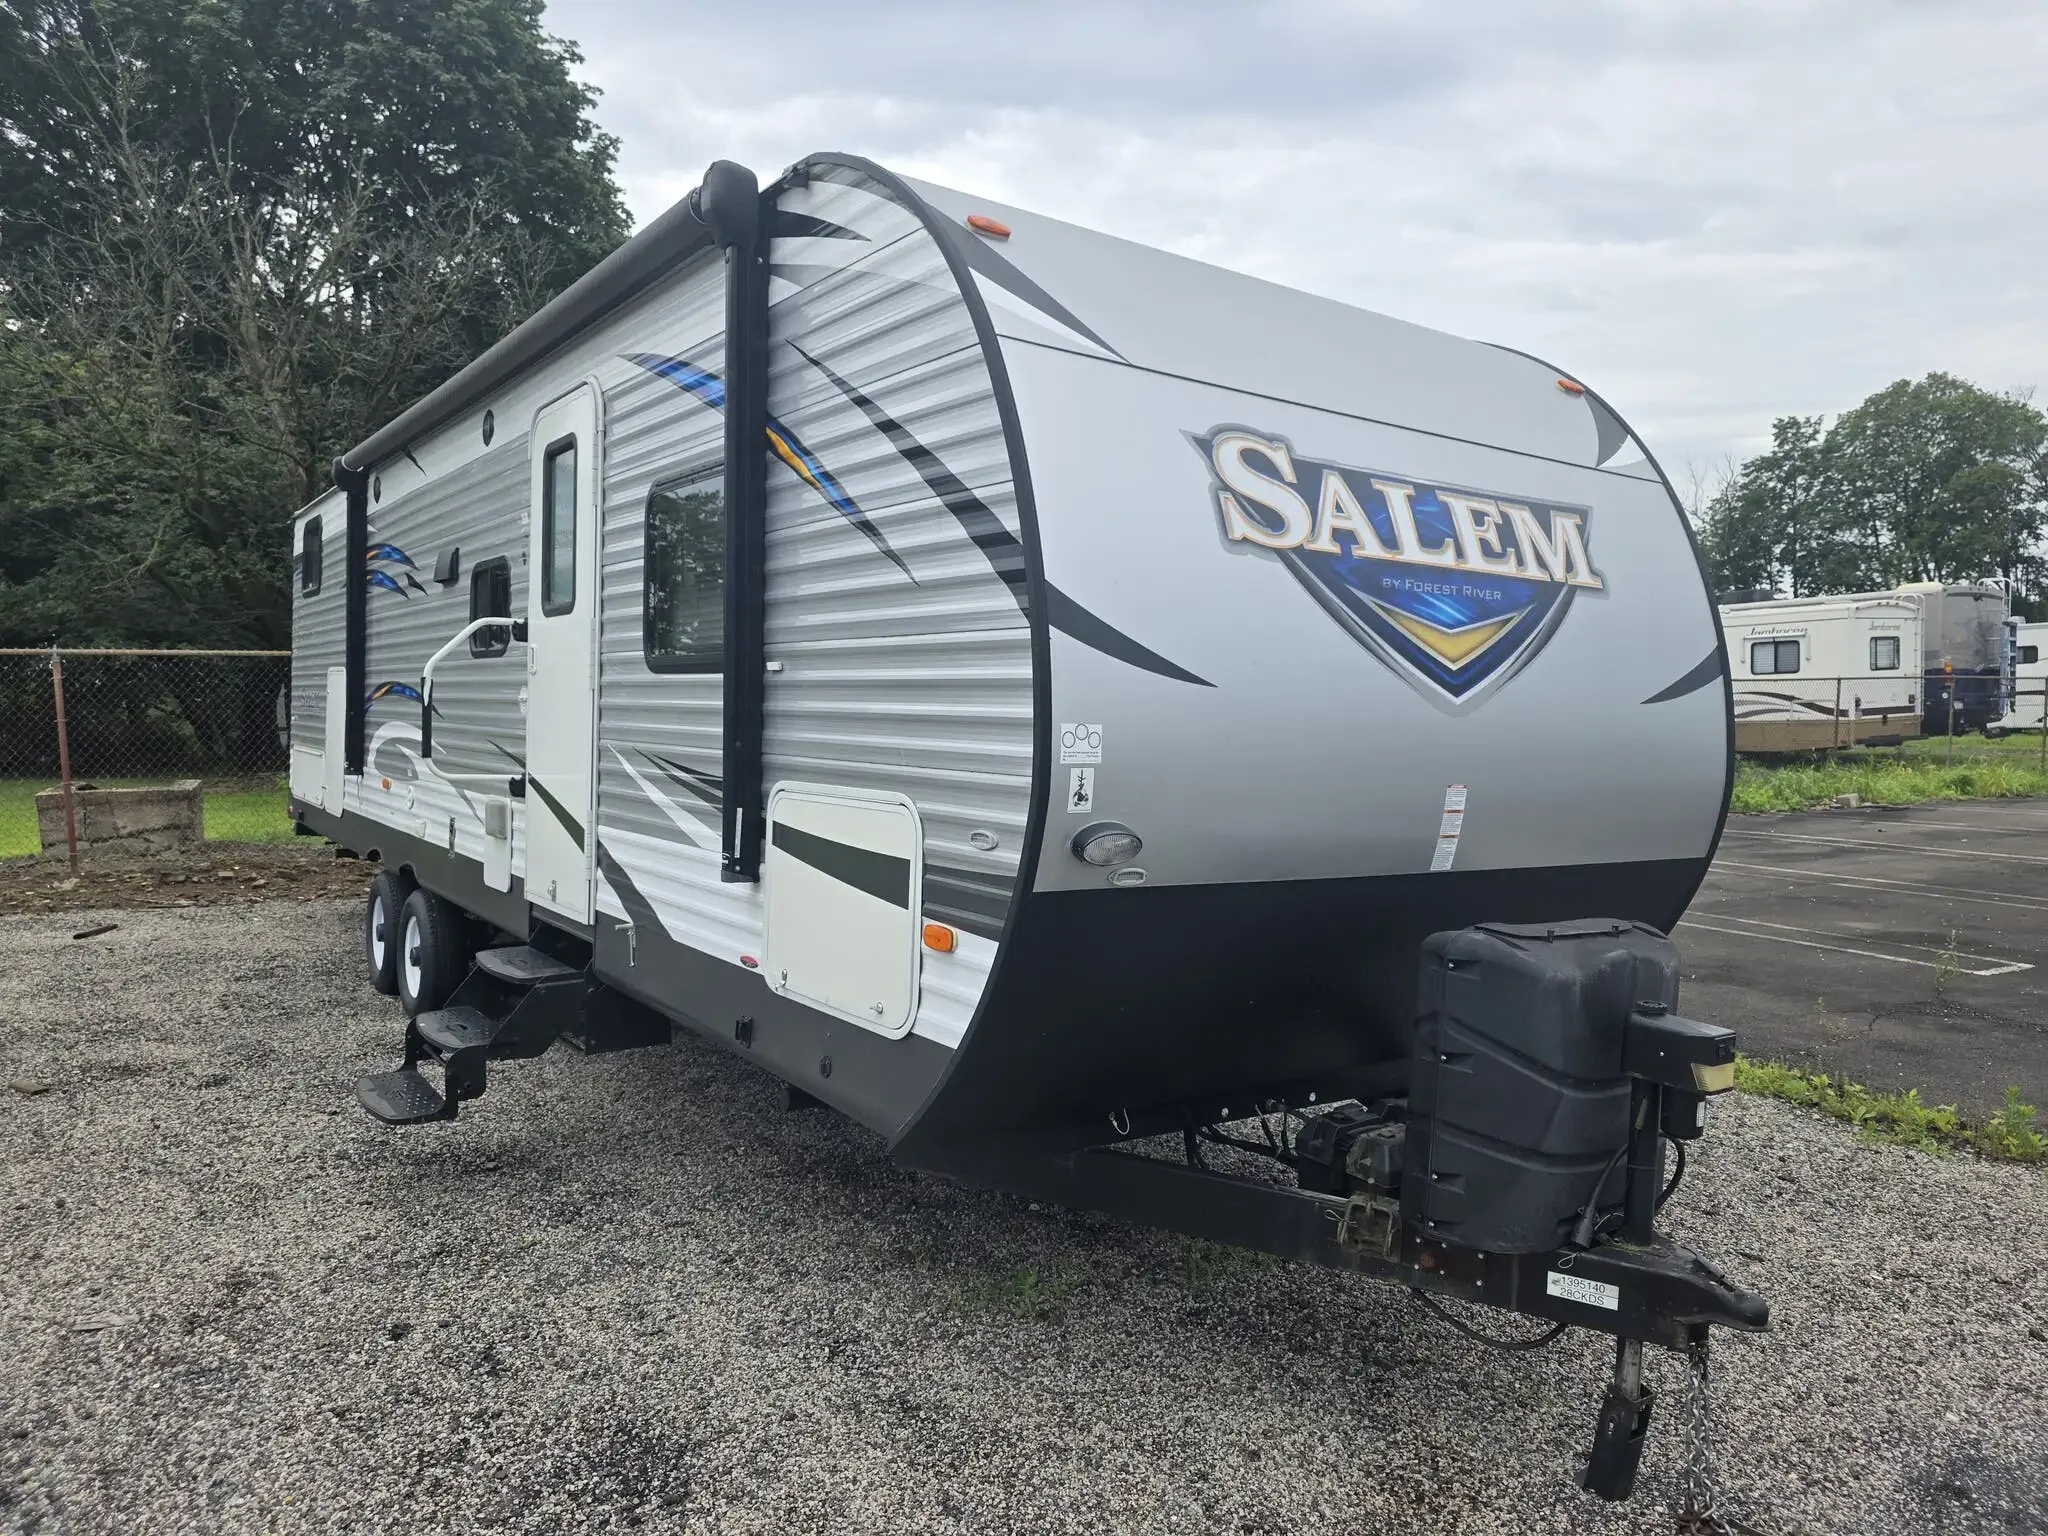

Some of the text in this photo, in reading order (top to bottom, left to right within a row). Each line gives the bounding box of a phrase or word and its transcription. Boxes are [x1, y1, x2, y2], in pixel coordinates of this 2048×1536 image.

[1212, 431, 1604, 588] SALEM
[1382, 578, 1502, 601] BY FOREST RIVER
[1561, 1276, 1606, 1294] 1395140
[1560, 1287, 1605, 1306] 28CKDS
